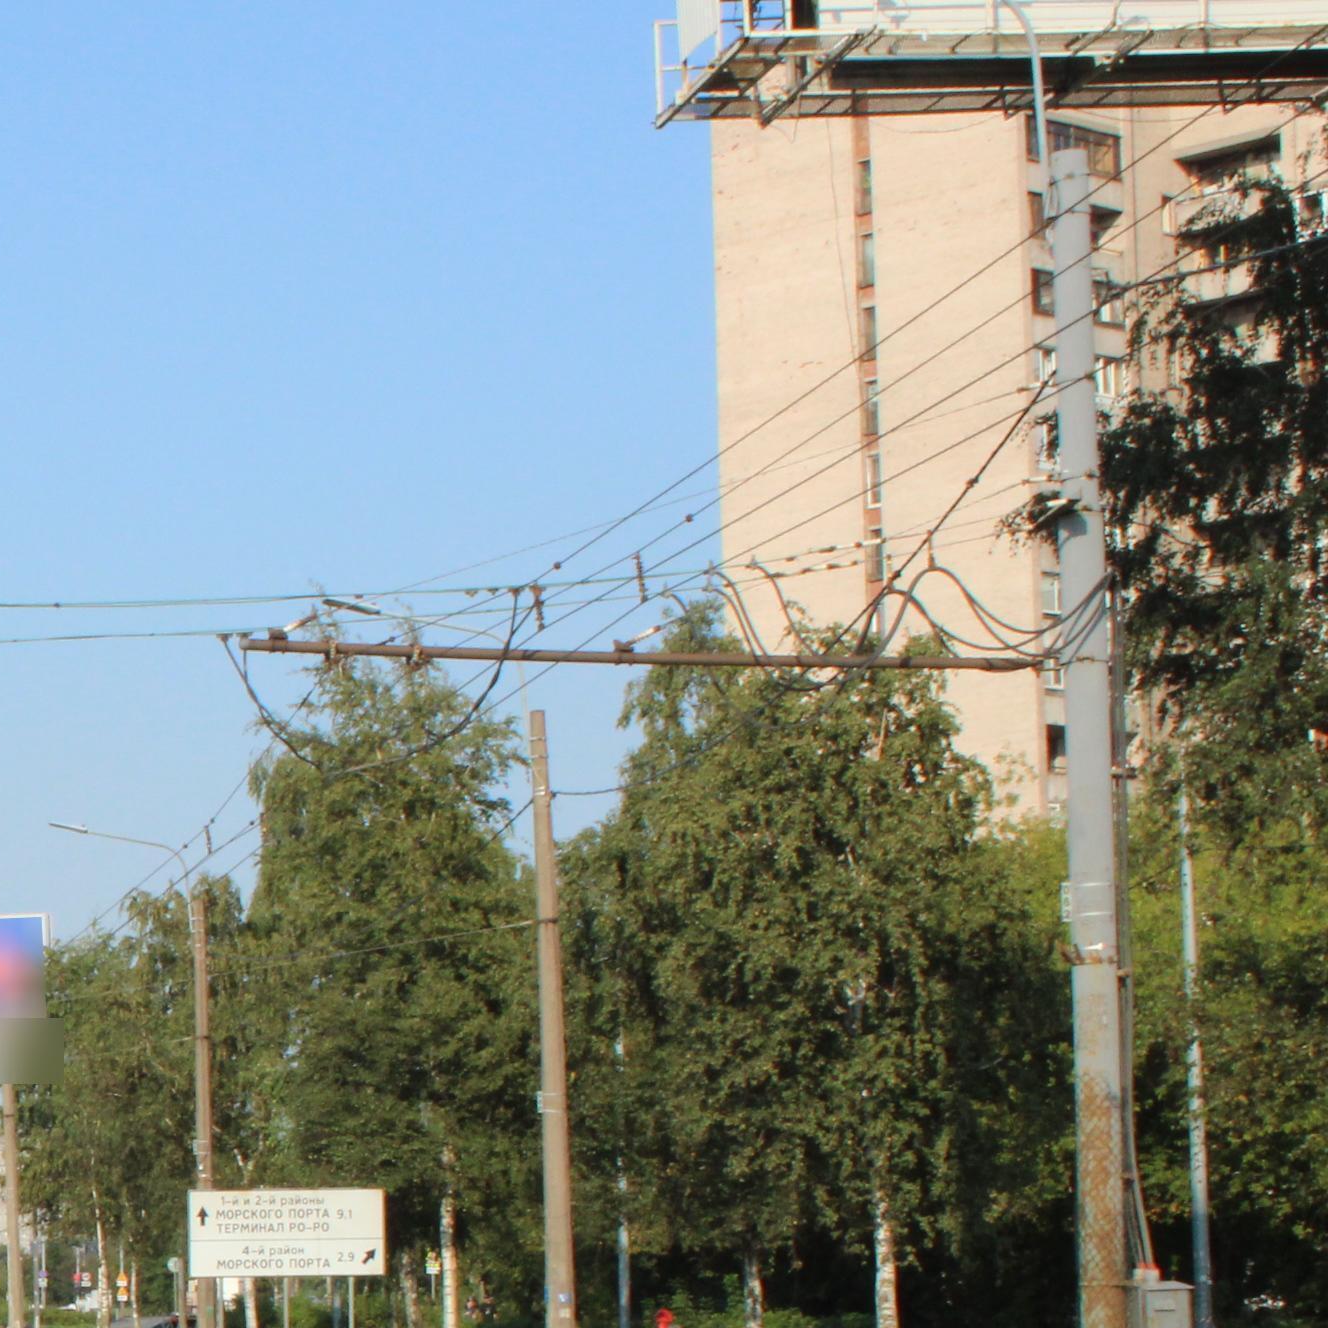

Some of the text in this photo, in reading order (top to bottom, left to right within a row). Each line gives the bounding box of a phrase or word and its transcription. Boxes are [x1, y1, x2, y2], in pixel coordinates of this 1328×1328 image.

[221, 1195, 325, 1207] 1-й и 2-й районы
[216, 1208, 283, 1220] МОРСКОГО
[288, 1208, 330, 1219] ПОРТА
[217, 1222, 330, 1234] ТЕРМИНАЛ РО-РО
[241, 1245, 305, 1257] 4-й район
[337, 1251, 355, 1263] 2.9
[216, 1257, 330, 1270] МОРСКОГО ПОРТА
